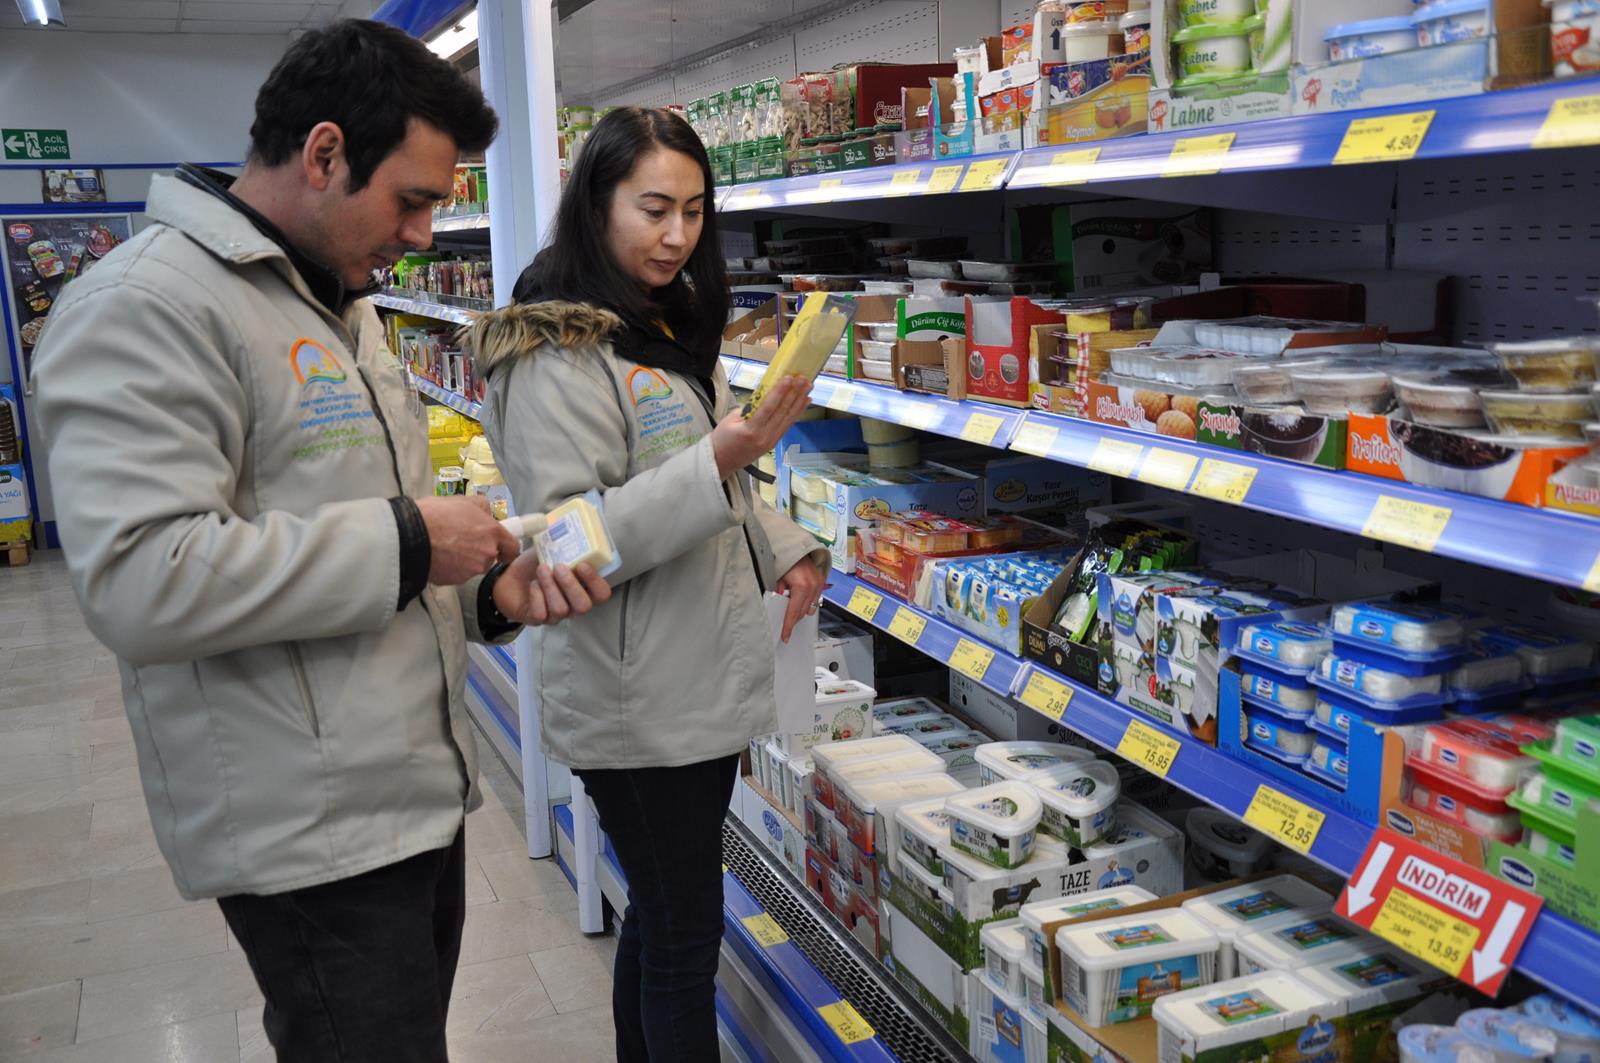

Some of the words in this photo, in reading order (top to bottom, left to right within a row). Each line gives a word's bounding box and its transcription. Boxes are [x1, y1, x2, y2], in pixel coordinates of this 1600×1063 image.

[1186, 50, 1217, 66] Labne
[1170, 105, 1215, 128] Labne
[911, 316, 936, 328] Dürüm
[937, 316, 949, 328] Çiğ
[1046, 698, 1064, 714] 2,95
[1144, 749, 1169, 770] 15,95
[974, 829, 988, 842] TAZE
[1279, 819, 1312, 845] 12,95
[1060, 870, 1091, 890] TAZE
[1427, 938, 1461, 963] 13,95
